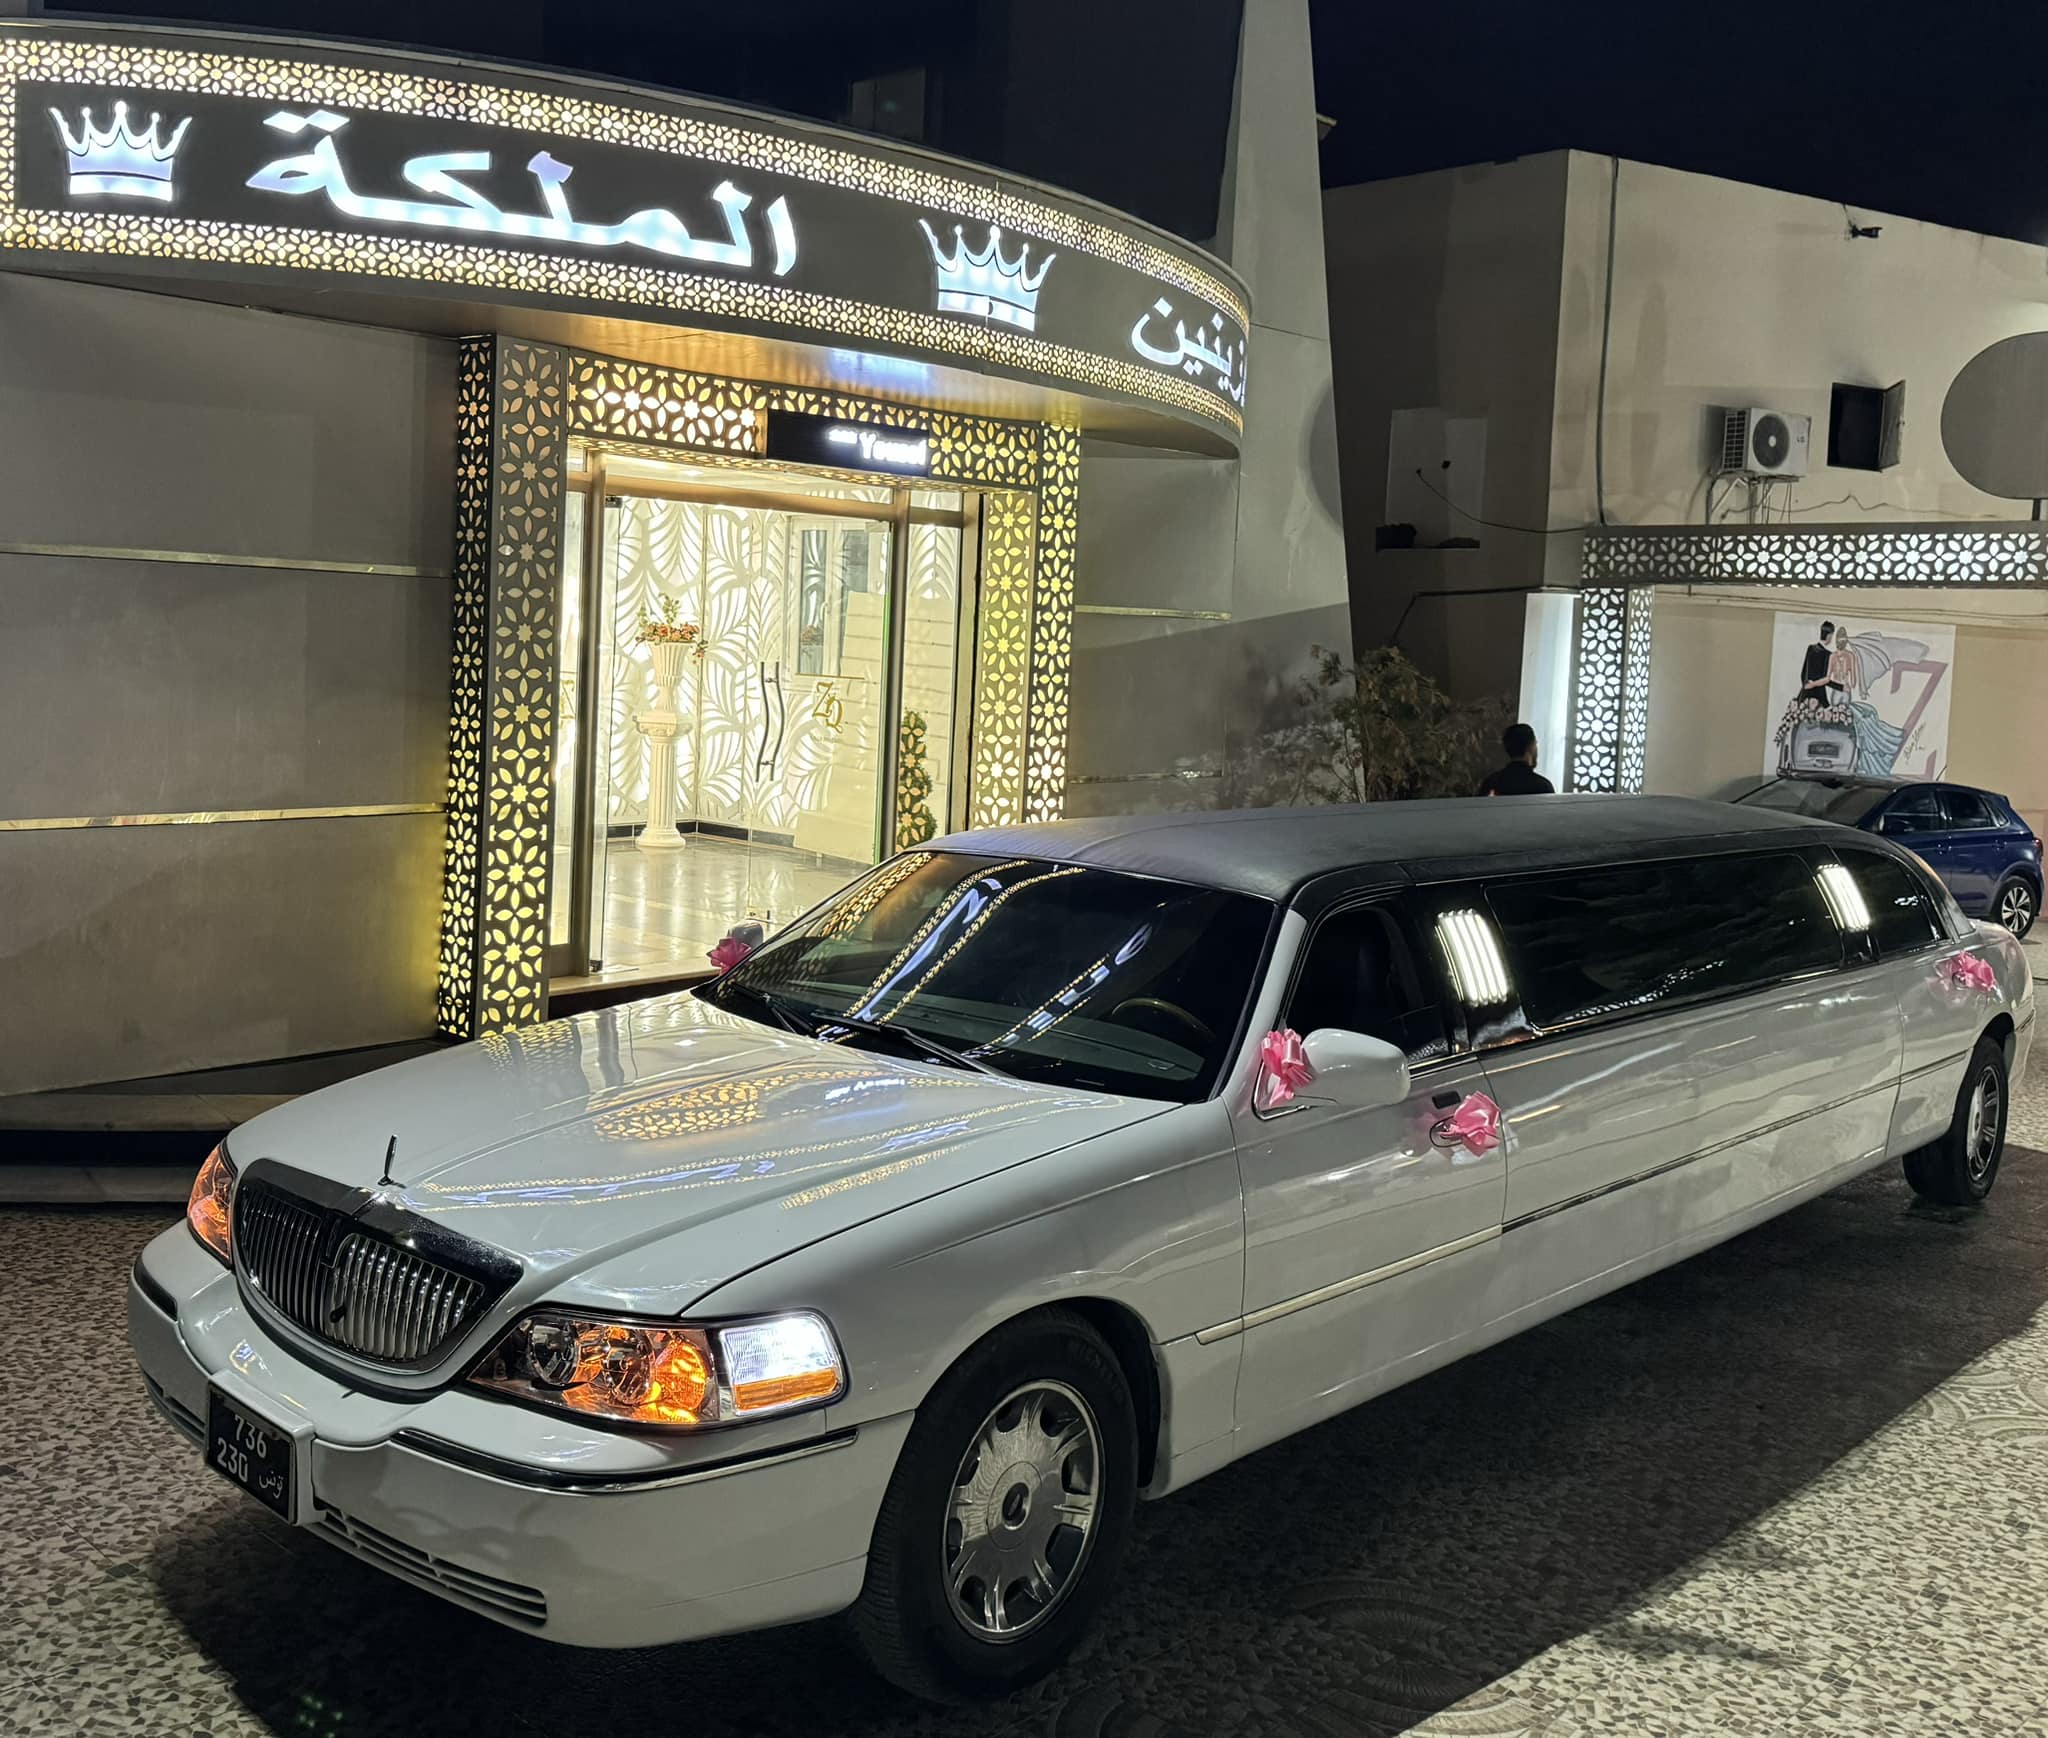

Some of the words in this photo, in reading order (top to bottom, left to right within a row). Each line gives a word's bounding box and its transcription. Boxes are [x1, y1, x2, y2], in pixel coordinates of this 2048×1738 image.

[245, 110, 797, 276] الملكة
[234, 1413, 267, 1459] 736
[217, 1437, 248, 1483] 230
